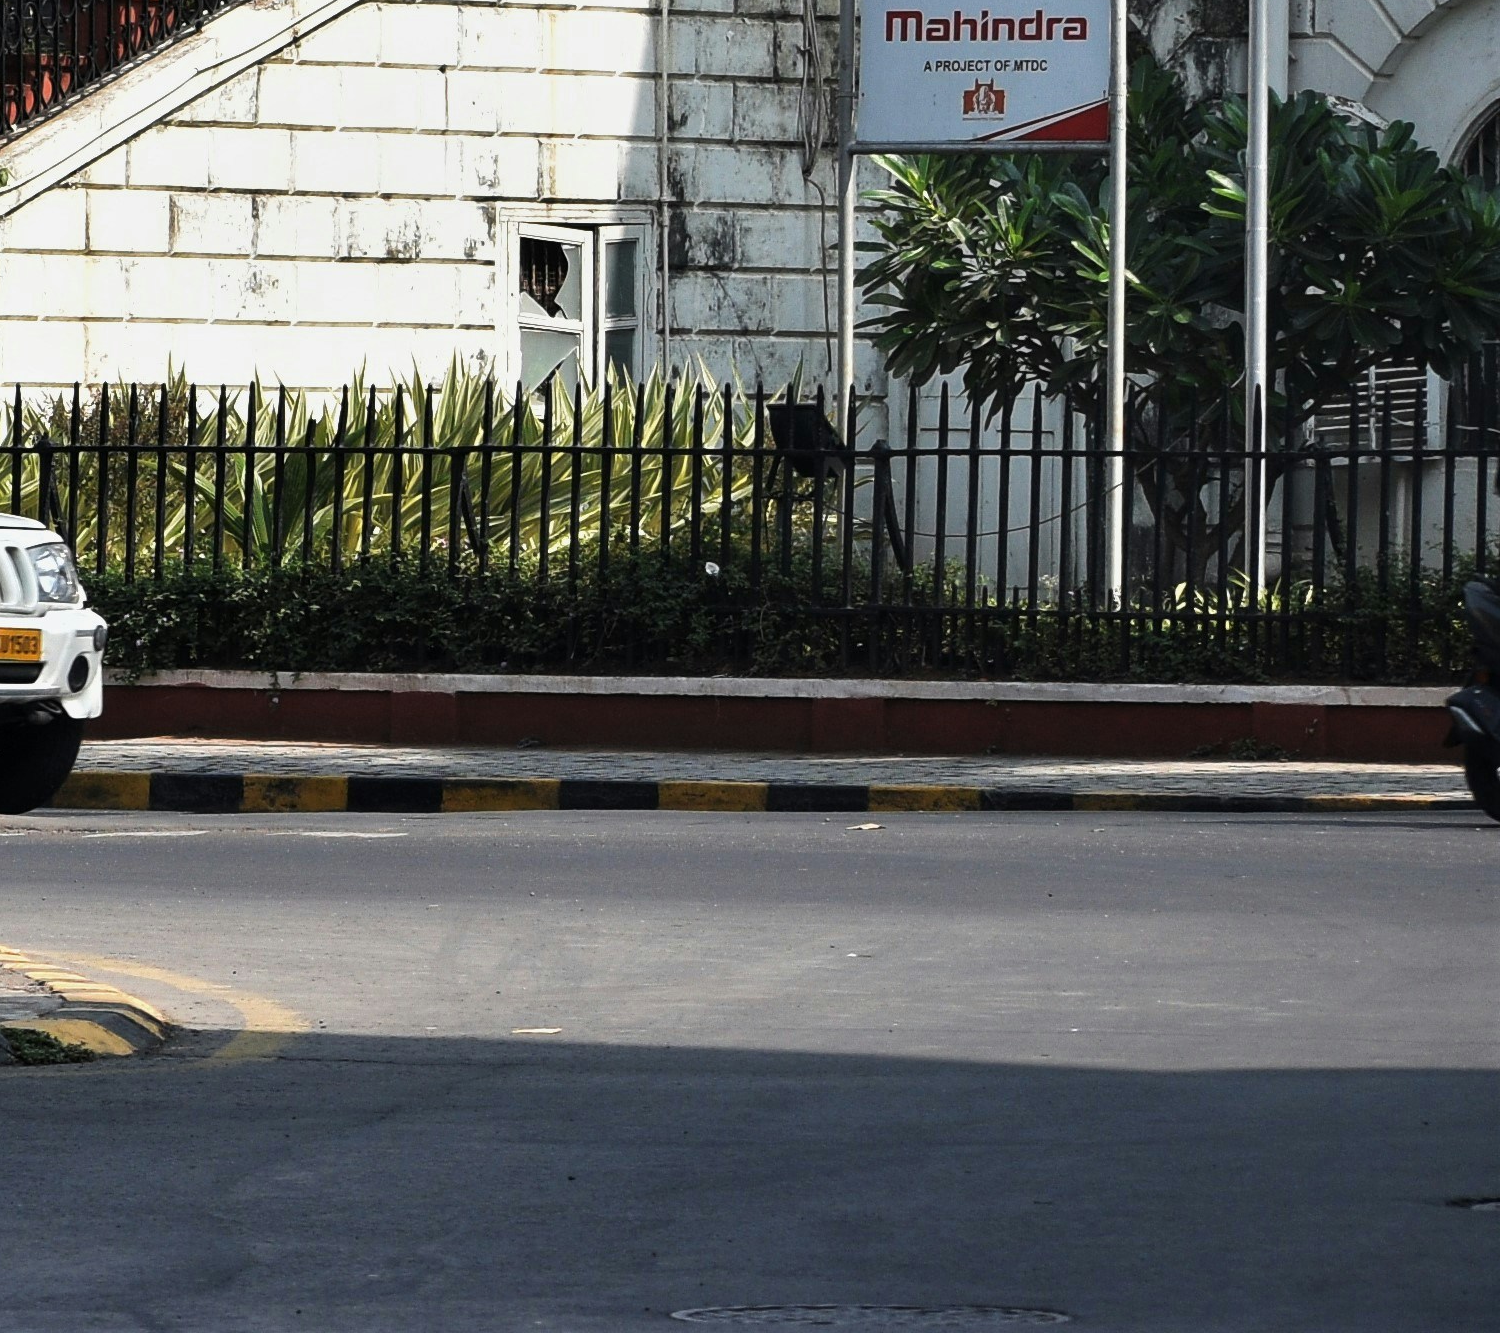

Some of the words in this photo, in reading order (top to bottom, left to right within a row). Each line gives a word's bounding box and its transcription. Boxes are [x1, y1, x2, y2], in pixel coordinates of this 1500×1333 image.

[885, 9, 1088, 43] Mahindra
[924, 60, 932, 72] A
[935, 60, 991, 73] PROJECT
[994, 60, 1011, 72] OF
[1014, 60, 1048, 72] MTDC
